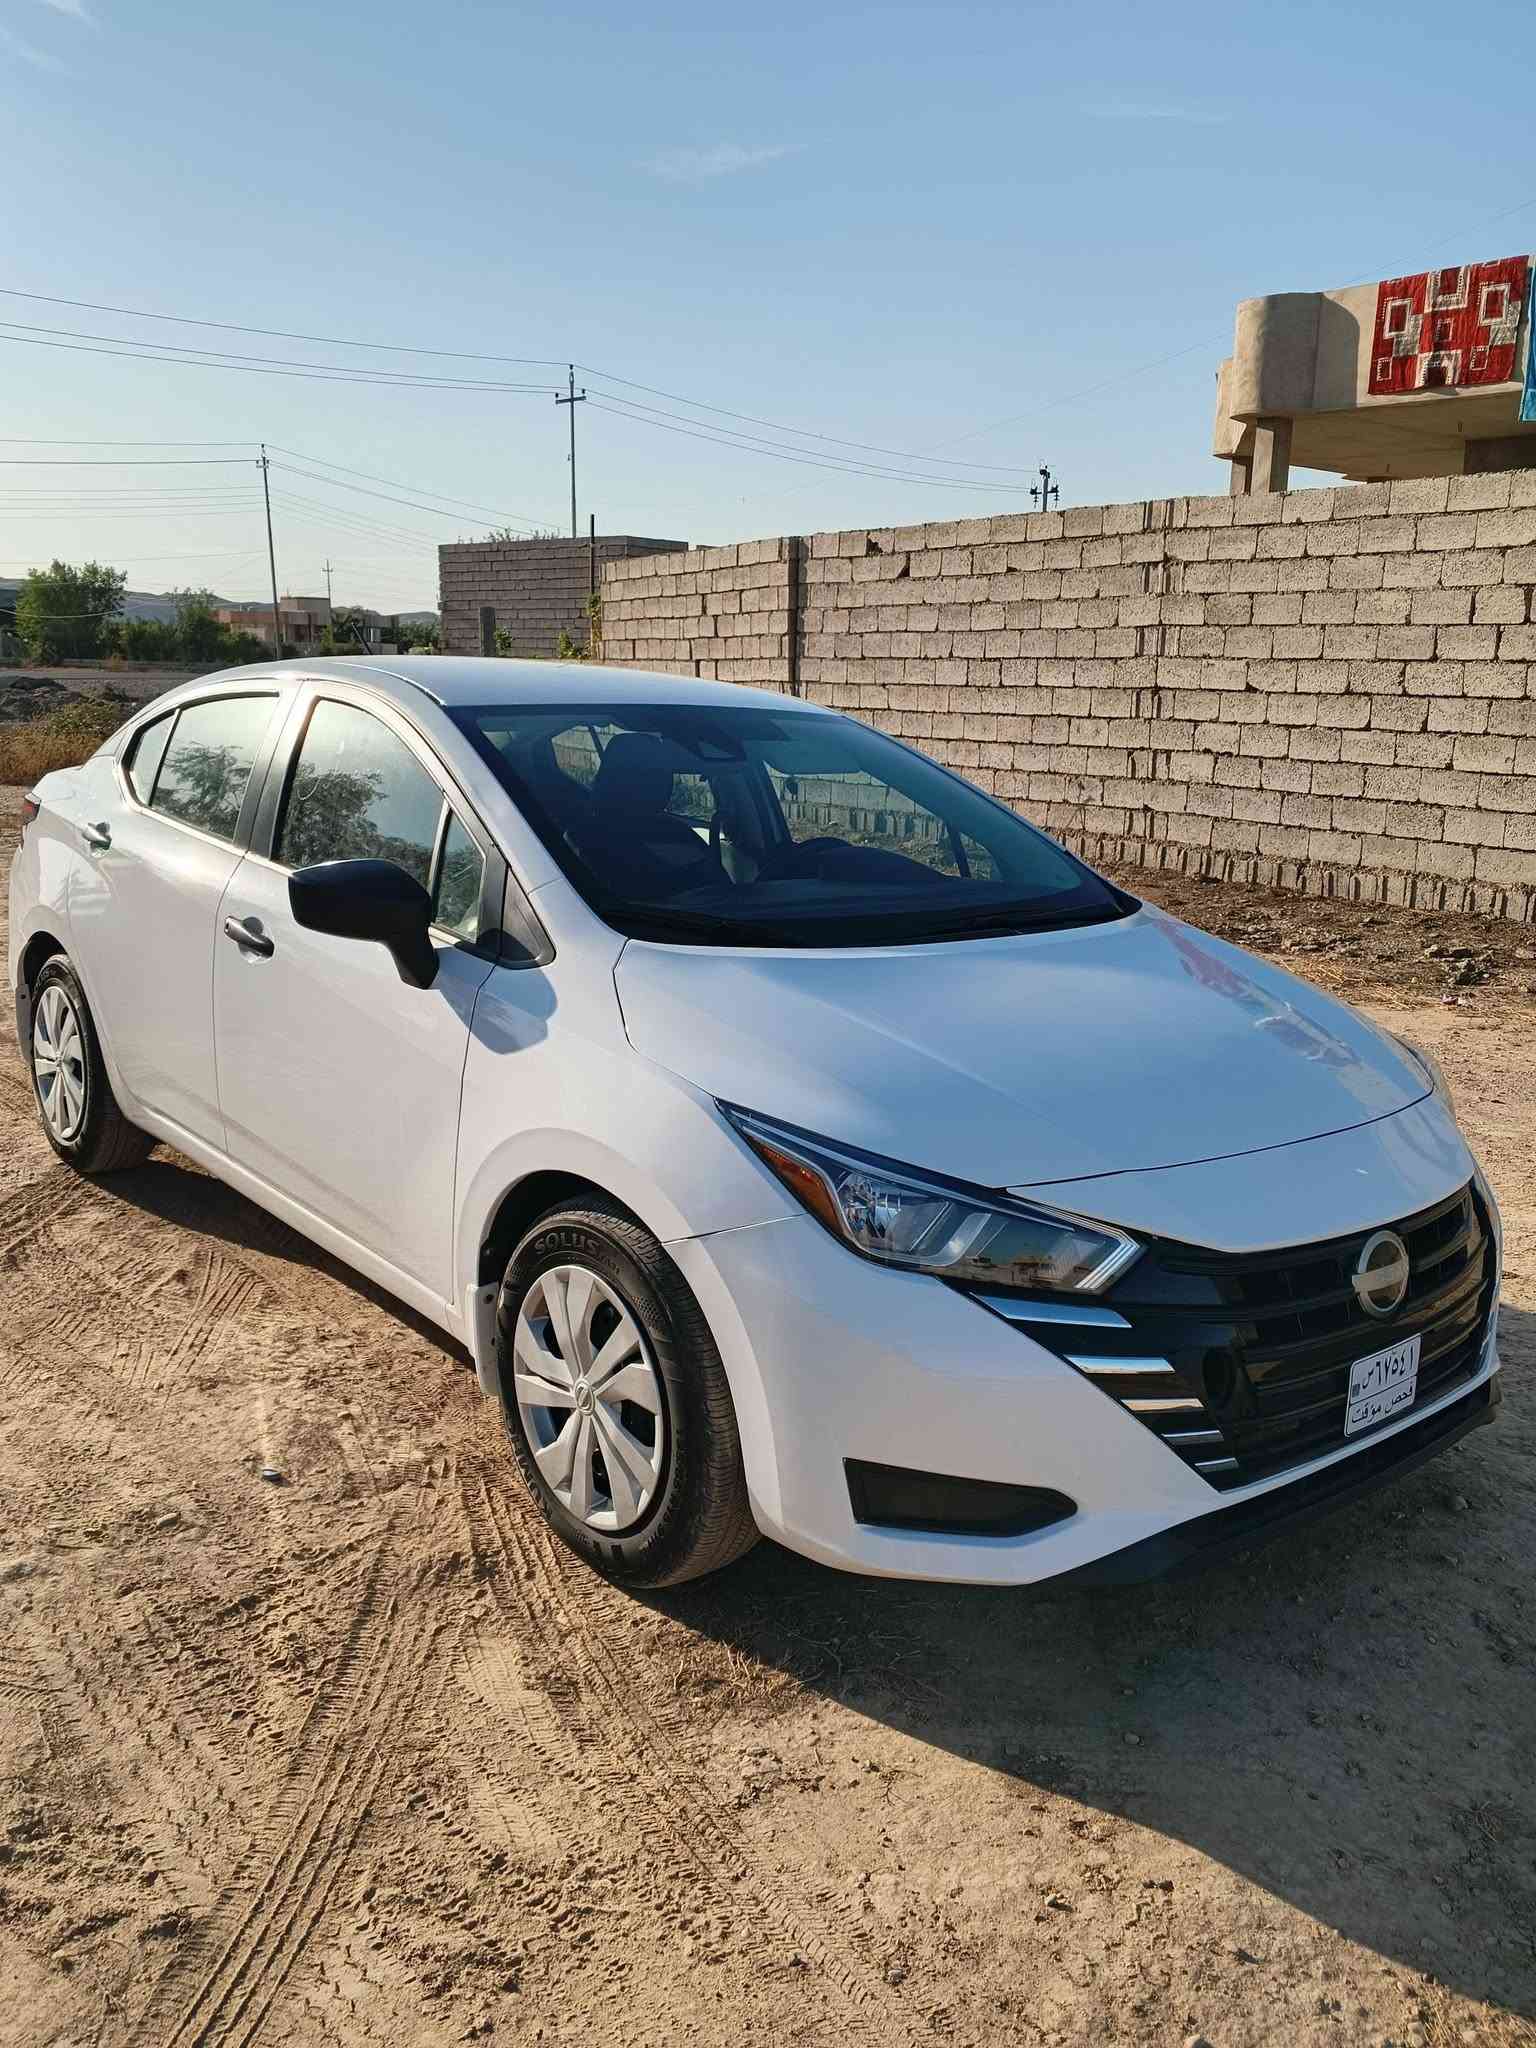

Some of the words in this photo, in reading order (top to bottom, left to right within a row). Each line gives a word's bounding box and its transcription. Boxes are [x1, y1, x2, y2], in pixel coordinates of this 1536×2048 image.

[534, 1232, 601, 1258] SOLUS
[1384, 1380, 1413, 1414] فحص
[1351, 1401, 1382, 1424] مؤقت
